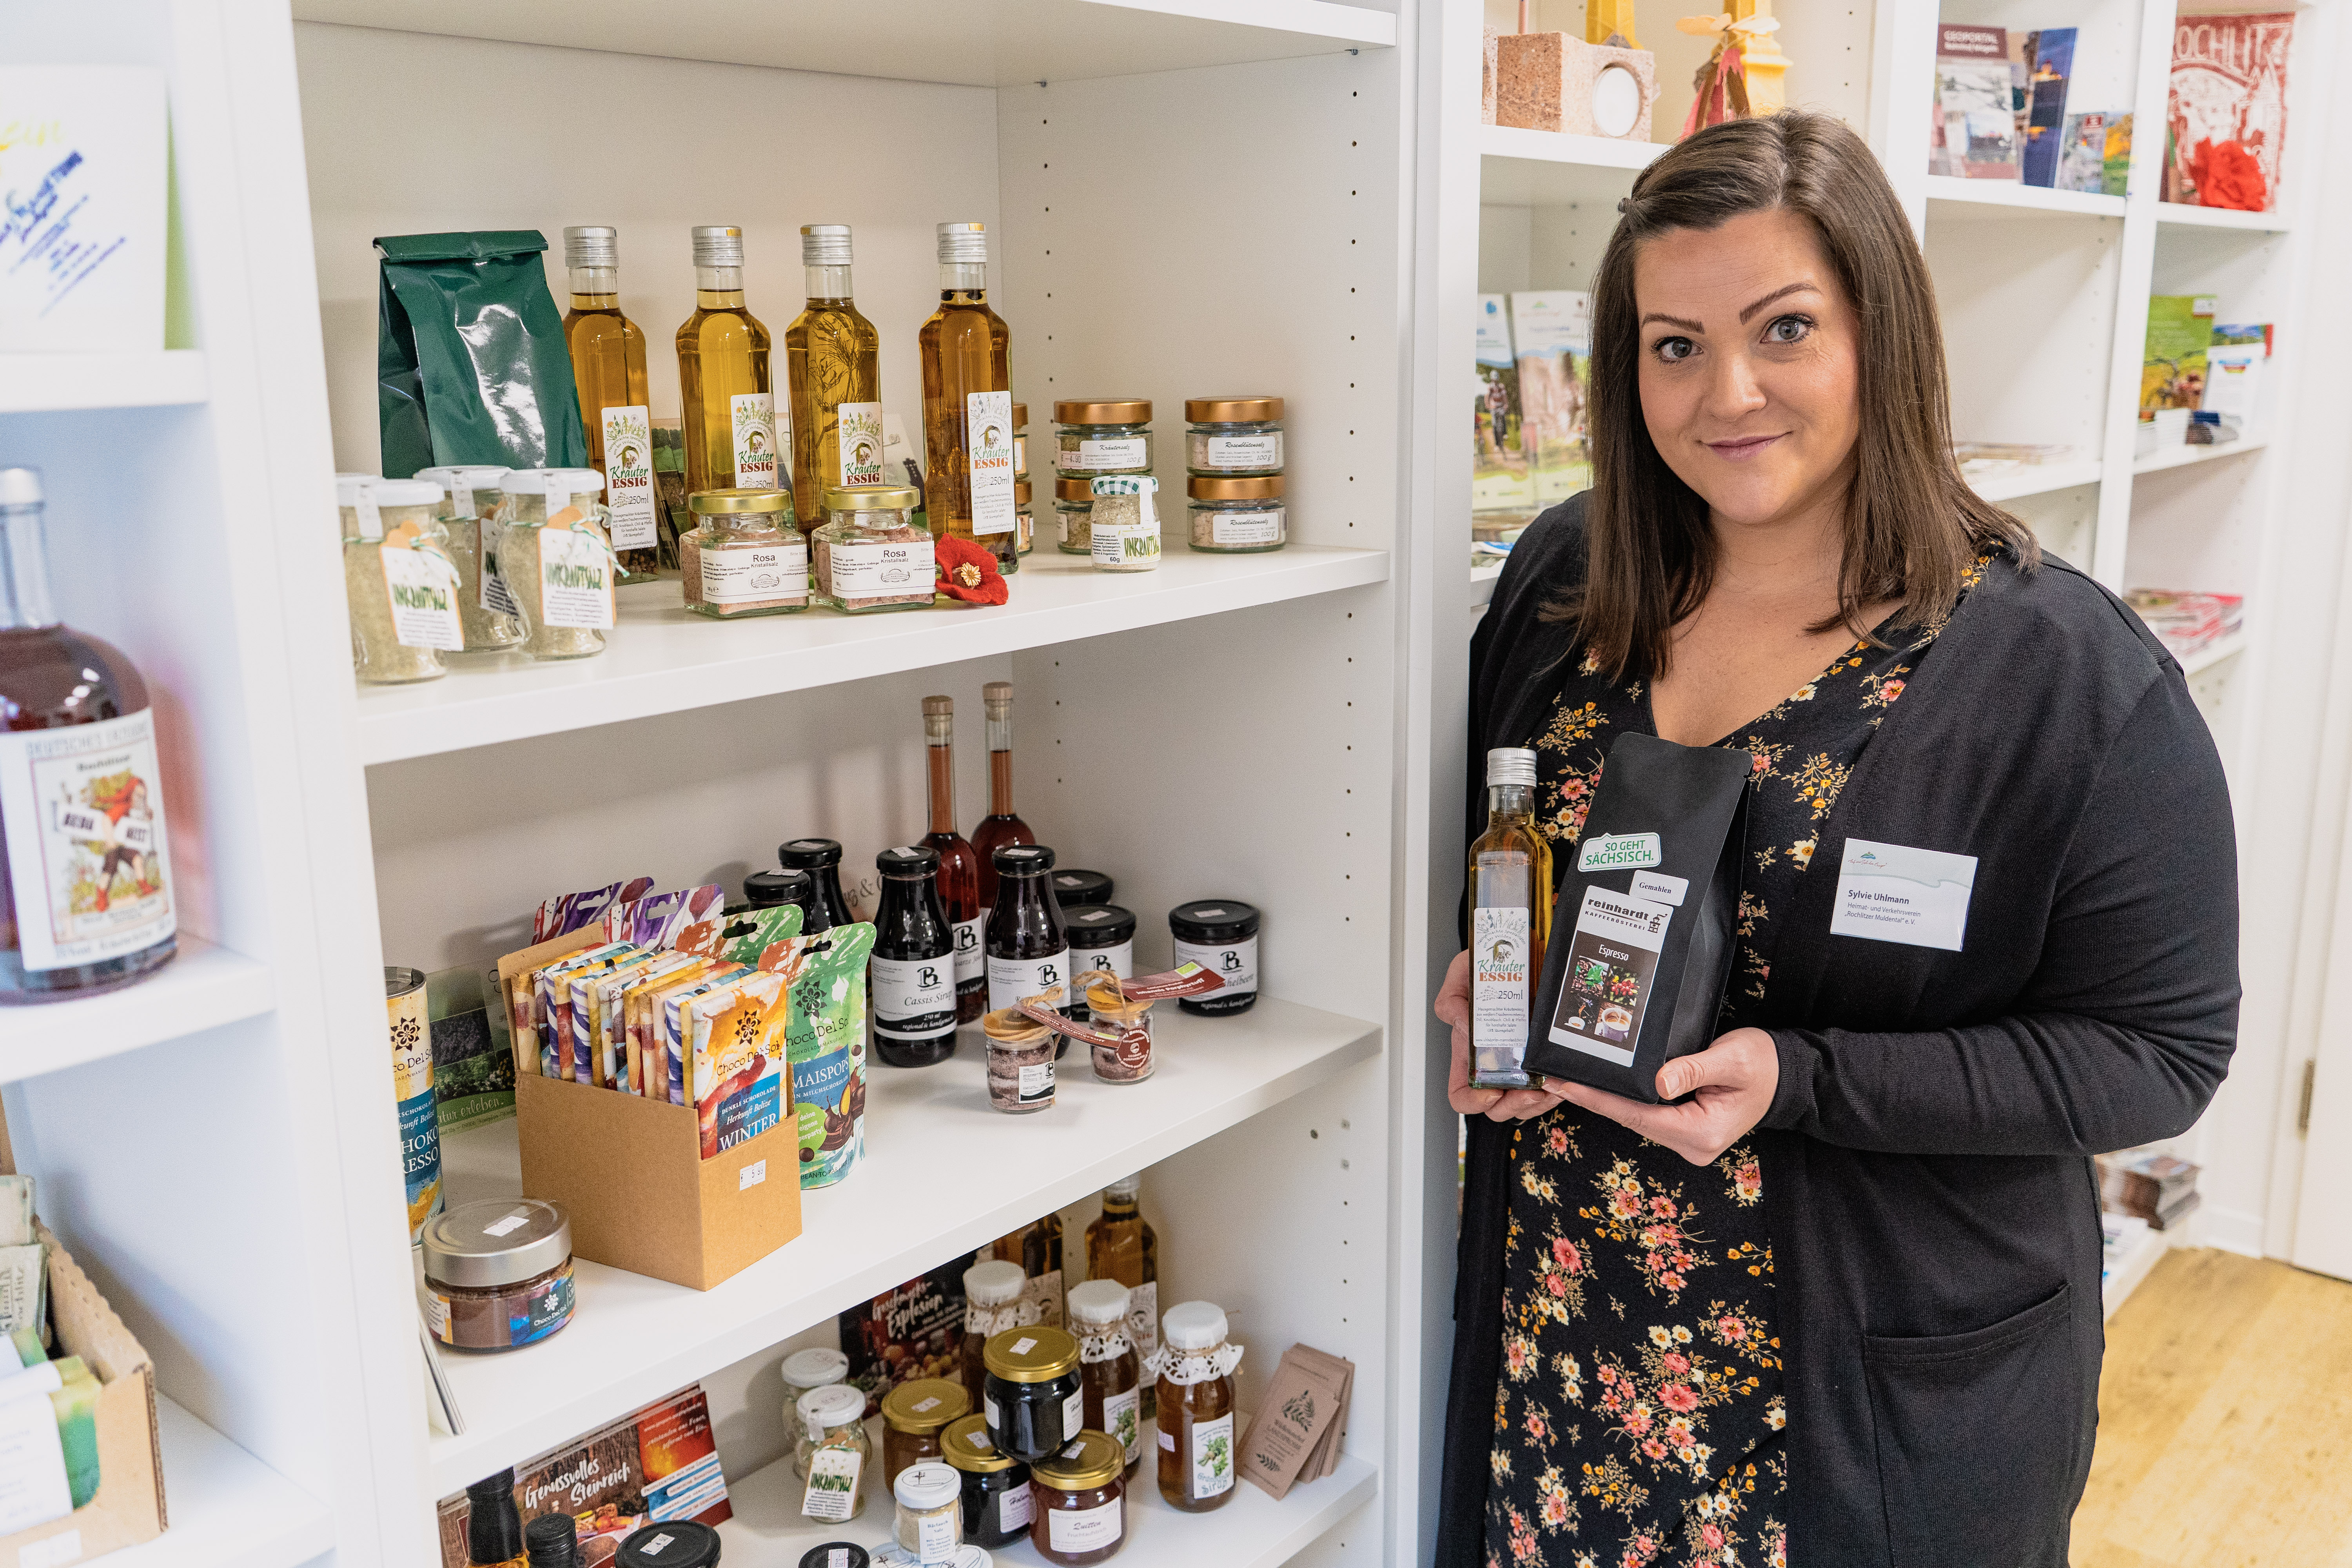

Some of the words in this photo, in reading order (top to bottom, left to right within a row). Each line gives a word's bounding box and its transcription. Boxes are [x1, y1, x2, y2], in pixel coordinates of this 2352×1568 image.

[2175, 22, 2293, 76] OCHLITZ
[737, 421, 756, 437] Hausgemachte
[757, 421, 773, 435] Spezialitäten
[970, 415, 992, 432] Hausgemachte
[993, 415, 1009, 429] Spezialitäten
[608, 436, 629, 452] Hausgemachte
[630, 436, 647, 450] Spezialitäten
[843, 433, 863, 449] Hausgemachte
[864, 433, 880, 446] Spezialitäten
[739, 450, 774, 464] Kräuter
[972, 445, 1009, 459] Kräuter
[740, 461, 773, 473] ESSIG
[845, 461, 881, 475] Kräuter
[974, 457, 1008, 469] ESSIG
[610, 465, 648, 479] Kräuter
[847, 473, 880, 485] ESSIG
[990, 474, 1009, 485] 250ml
[612, 476, 647, 489] ESSIG
[755, 478, 775, 488] 250ml
[629, 493, 649, 505] 250ml
[753, 554, 775, 563] Rosa
[1605, 842, 1617, 851] SO
[1620, 840, 1646, 850] GEHT
[1585, 850, 1654, 866] SÄCHSISCH.
[1639, 882, 1672, 894] Gemahlen
[1848, 889, 1872, 900] Sylvie
[1874, 893, 1909, 904] Uhlmann
[1588, 898, 1649, 921] reinhardt
[1844, 911, 1874, 920] „Rochlitzer
[1875, 915, 1904, 923] Muldental“
[1847, 902, 1869, 910] Heimat-
[1882, 906, 1921, 917] Verkehrsverein
[1585, 910, 1646, 931] KAFFEERÖSTEREI
[1476, 929, 1503, 945] Hausgemachte
[1505, 929, 1526, 945] Spezialitäten
[1512, 937, 1520, 948] Wiese
[1599, 944, 1629, 961] Espresso
[1477, 959, 1525, 972] Kräuter
[1166, 977, 1205, 992] Porphyrtuff
[1479, 972, 1523, 982] ESSIG
[904, 995, 933, 1006] Cassis
[934, 990, 952, 1003] Sirup
[1498, 989, 1523, 1000] 250ml
[784, 1027, 815, 1047] hoco
[817, 1021, 837, 1037] Del
[408, 1053, 424, 1069] Del
[717, 1057, 746, 1076] Choco
[748, 1047, 762, 1062] Del
[765, 1040, 780, 1055] Sol
[793, 1056, 849, 1089] MAISPOPS
[461, 1097, 504, 1116] erleben.
[722, 1102, 742, 1114] DUNKLE
[742, 1085, 776, 1104] SCHOKOLADE
[726, 1105, 753, 1125] Herkunft
[754, 1099, 771, 1112] Belize
[800, 1112, 816, 1122] deine
[719, 1112, 777, 1151] WINTER
[799, 1120, 818, 1131] eigene
[401, 1125, 439, 1154] HOKO
[798, 1126, 824, 1143] perparty!
[413, 1217, 424, 1226] BIO
[534, 1316, 552, 1326] Choco
[525, 1458, 600, 1509] Genussvolles
[570, 1461, 631, 1507] Steinreich
[1073, 1521, 1101, 1530] Quitten
